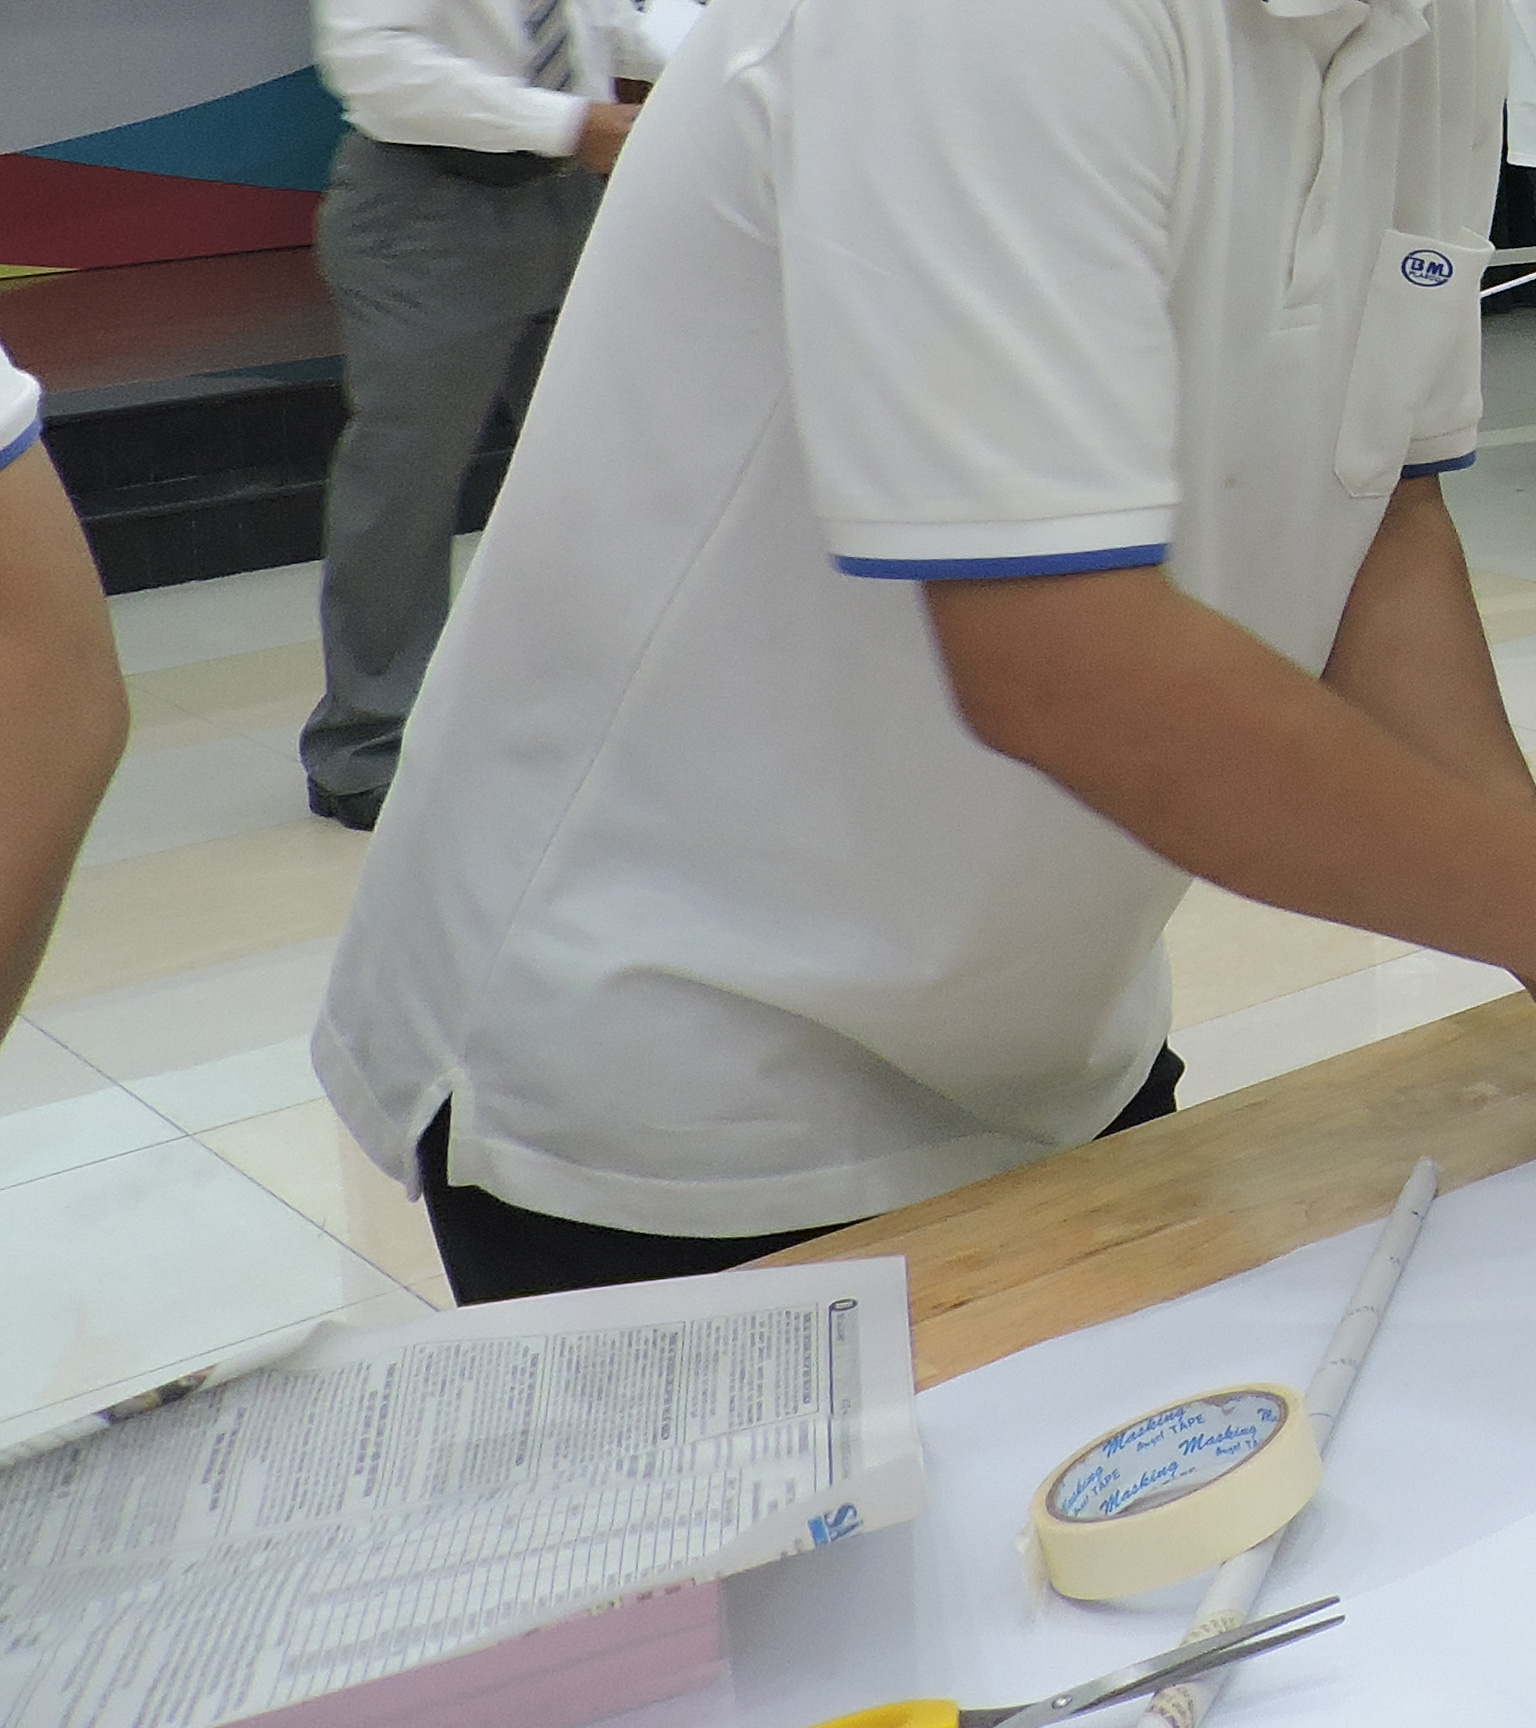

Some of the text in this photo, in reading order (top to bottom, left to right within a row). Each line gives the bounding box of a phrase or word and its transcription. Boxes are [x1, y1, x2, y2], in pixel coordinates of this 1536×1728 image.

[1410, 256, 1445, 275] BM
[1102, 1407, 1187, 1458] Masking
[1169, 1413, 1205, 1434] TAPE
[1178, 1424, 1258, 1456] Masking
[1100, 1460, 1180, 1516] Masking
